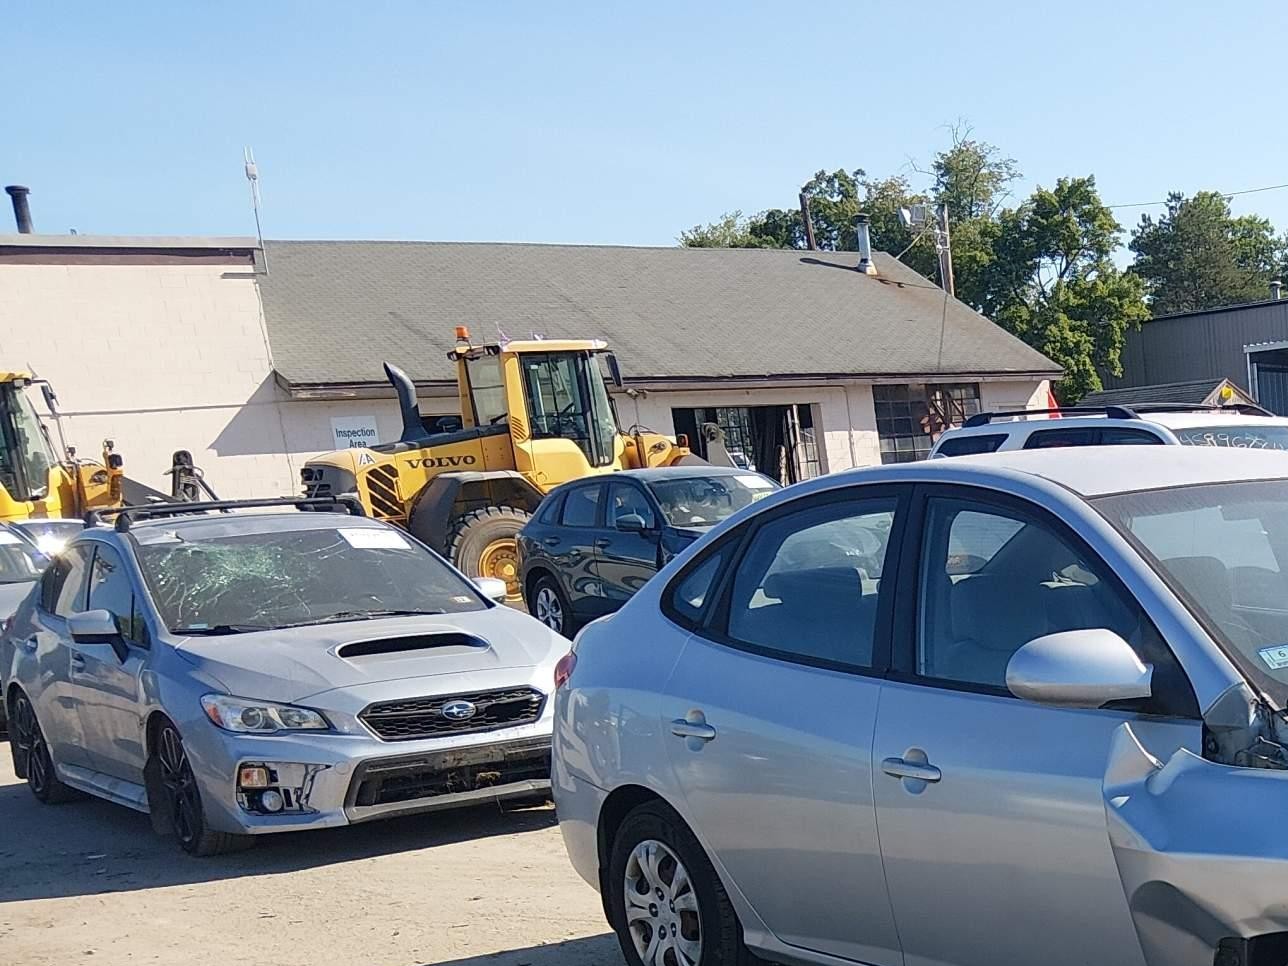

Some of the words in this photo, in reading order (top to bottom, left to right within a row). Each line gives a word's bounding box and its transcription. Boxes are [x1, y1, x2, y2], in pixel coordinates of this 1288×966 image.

[335, 427, 376, 439] Inspection
[349, 439, 367, 449] Area
[406, 455, 476, 469] VOLVO
[1278, 650, 1287, 658] 6
